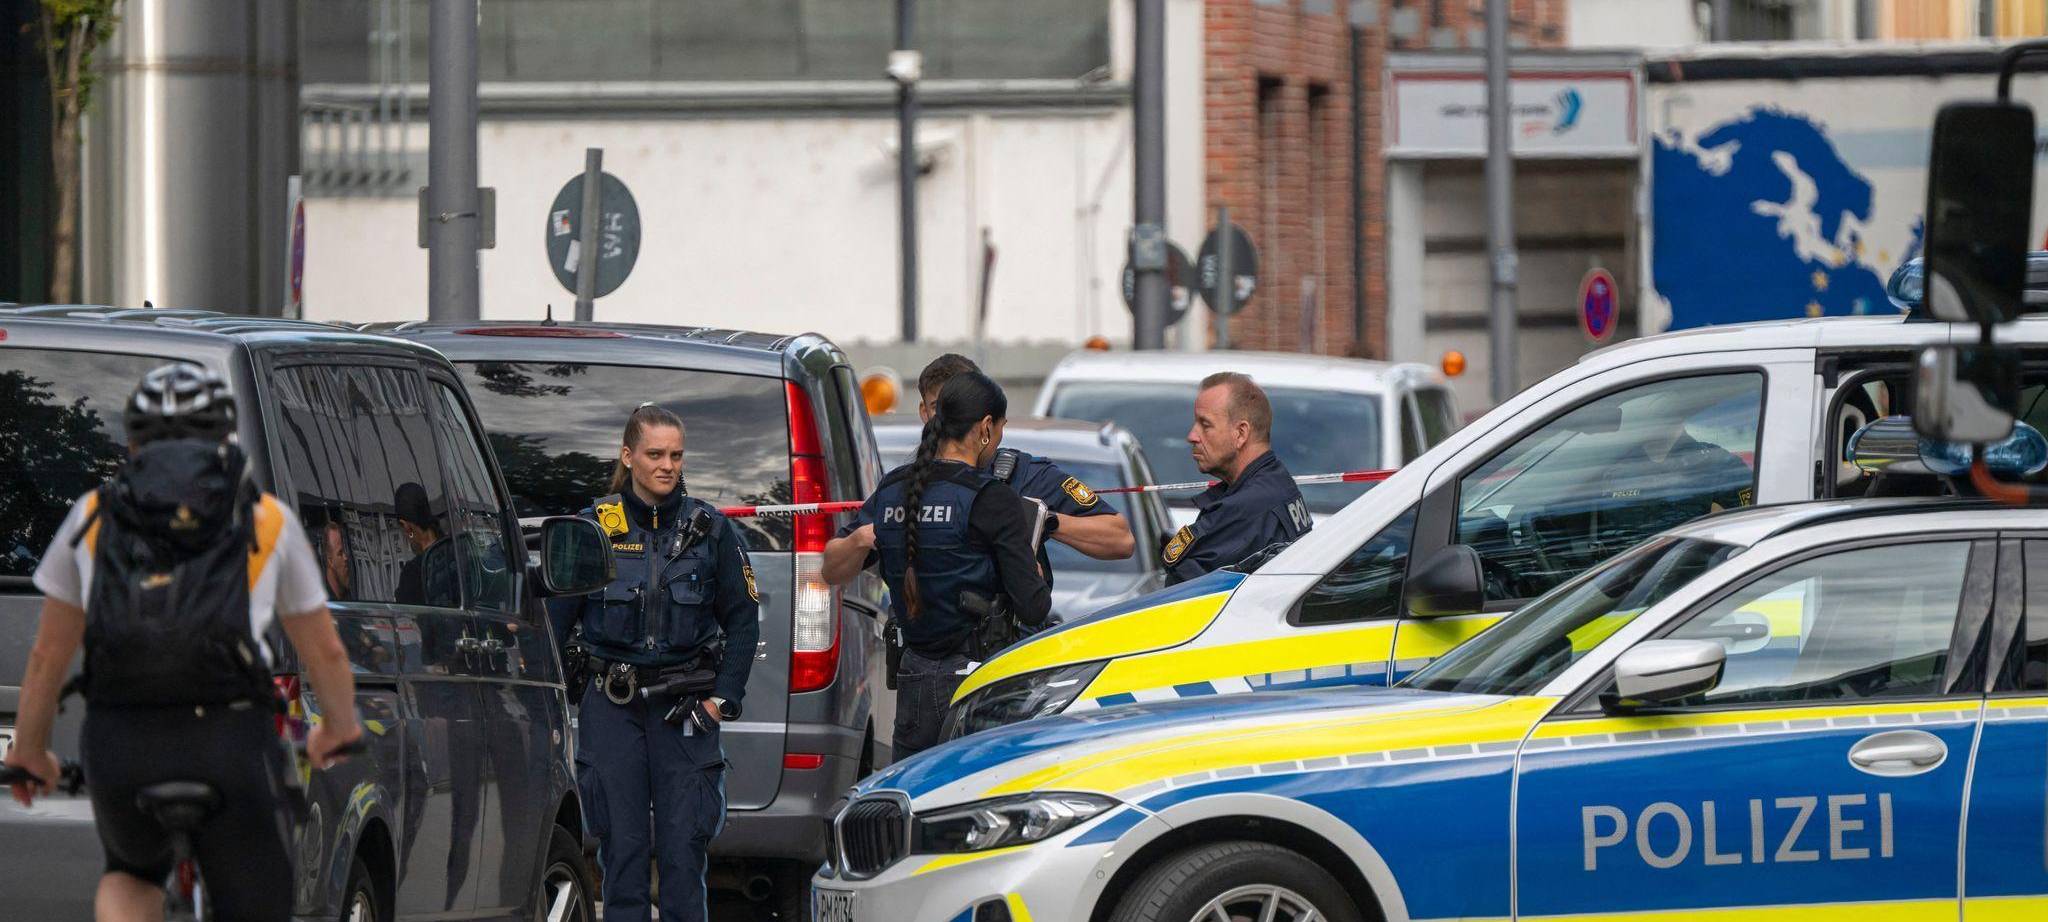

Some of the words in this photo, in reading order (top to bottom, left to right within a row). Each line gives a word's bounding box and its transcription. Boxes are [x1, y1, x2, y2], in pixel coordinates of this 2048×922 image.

[883, 505, 952, 523] POZEI
[612, 543, 643, 551] POLIZEI
[1582, 793, 1894, 871] POLIZEI
